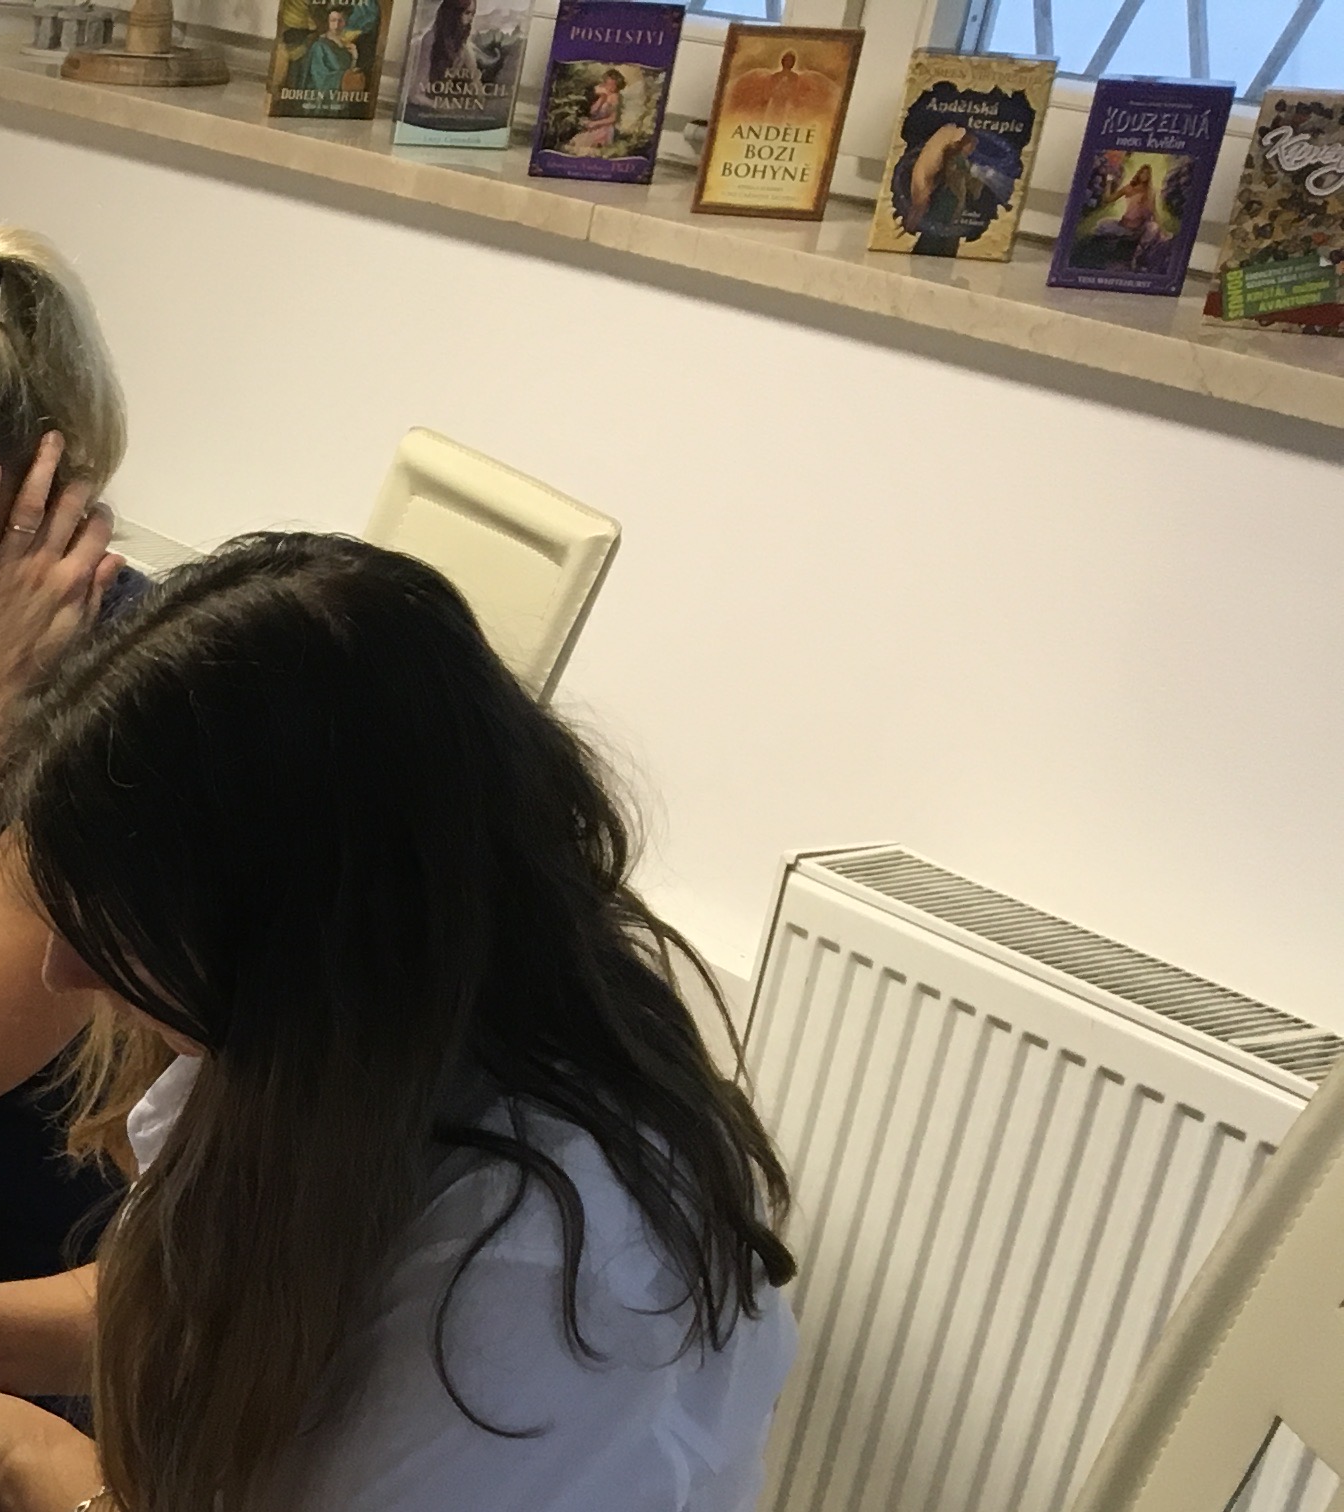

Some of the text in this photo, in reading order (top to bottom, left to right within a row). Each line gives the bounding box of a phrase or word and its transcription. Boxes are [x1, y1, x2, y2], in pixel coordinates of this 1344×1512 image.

[281, 88, 369, 102] DOREEN VIRTUE
[744, 144, 796, 162] BOZI
[721, 162, 812, 183] BOHYNĚ
[1226, 270, 1244, 318] BONUS
